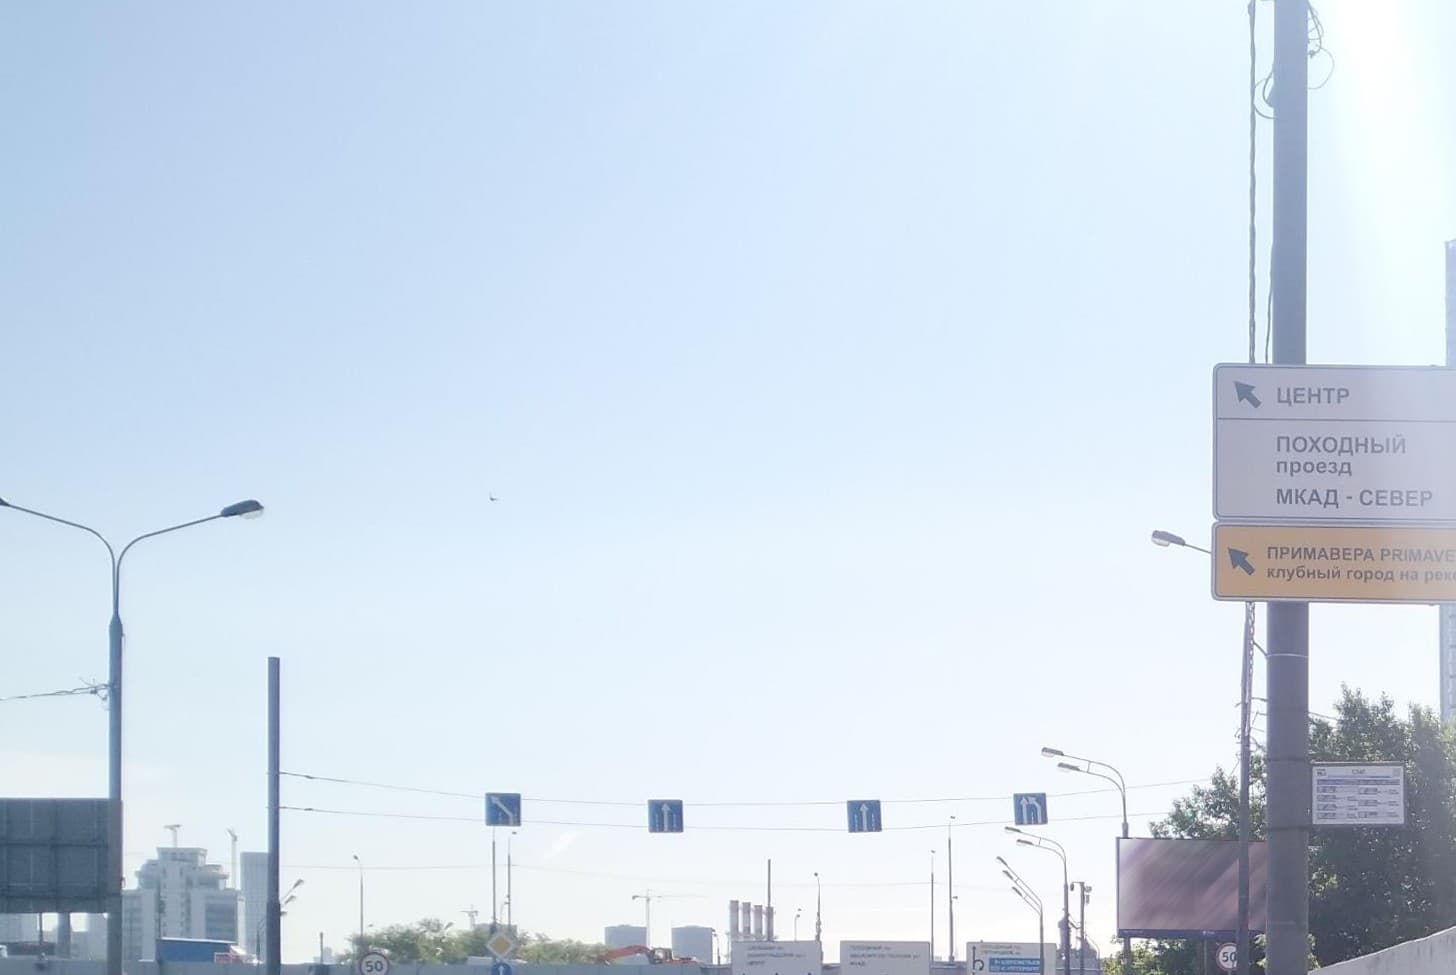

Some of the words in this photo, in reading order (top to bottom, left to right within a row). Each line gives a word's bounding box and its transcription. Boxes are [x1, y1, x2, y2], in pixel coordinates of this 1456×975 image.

[1277, 388, 1350, 407] ЦЕНТР
[1277, 434, 1407, 457] ПОХОДНЫЙ
[1277, 460, 1352, 478] проезд
[1277, 488, 1339, 509] МКАД
[1359, 490, 1433, 507] СЕВЕР
[1267, 547, 1375, 561] ПРИМАВЕРА
[1267, 566, 1341, 581] клубный
[1346, 567, 1395, 583] город
[1399, 570, 1419, 581] на
[1222, 951, 1237, 962] 50
[365, 960, 384, 972] 50
